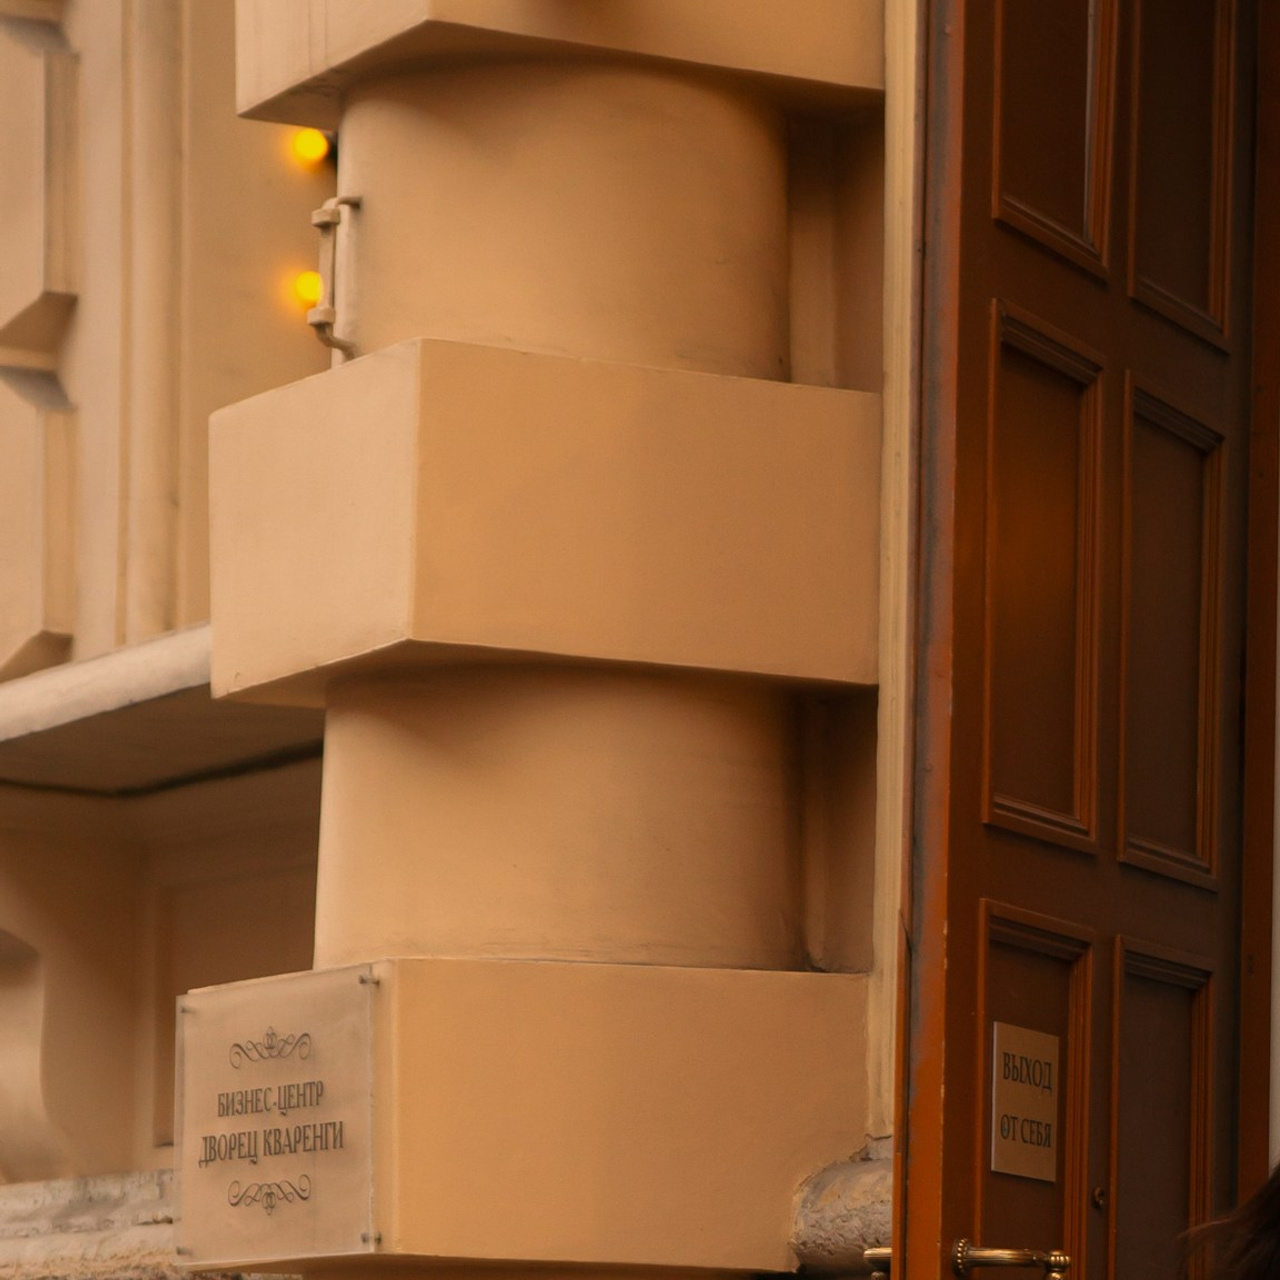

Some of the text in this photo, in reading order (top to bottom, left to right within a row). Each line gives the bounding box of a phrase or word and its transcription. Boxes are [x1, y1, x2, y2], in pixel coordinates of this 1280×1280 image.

[1002, 1052, 1053, 1095] ВЫХОД
[217, 1080, 325, 1118] БИЗНЕС-ЦЕНТР
[198, 1121, 345, 1169] ДВОРЕЦ КВАРЕНГИ
[1000, 1114, 1052, 1149] ОТ СЕБЯ
